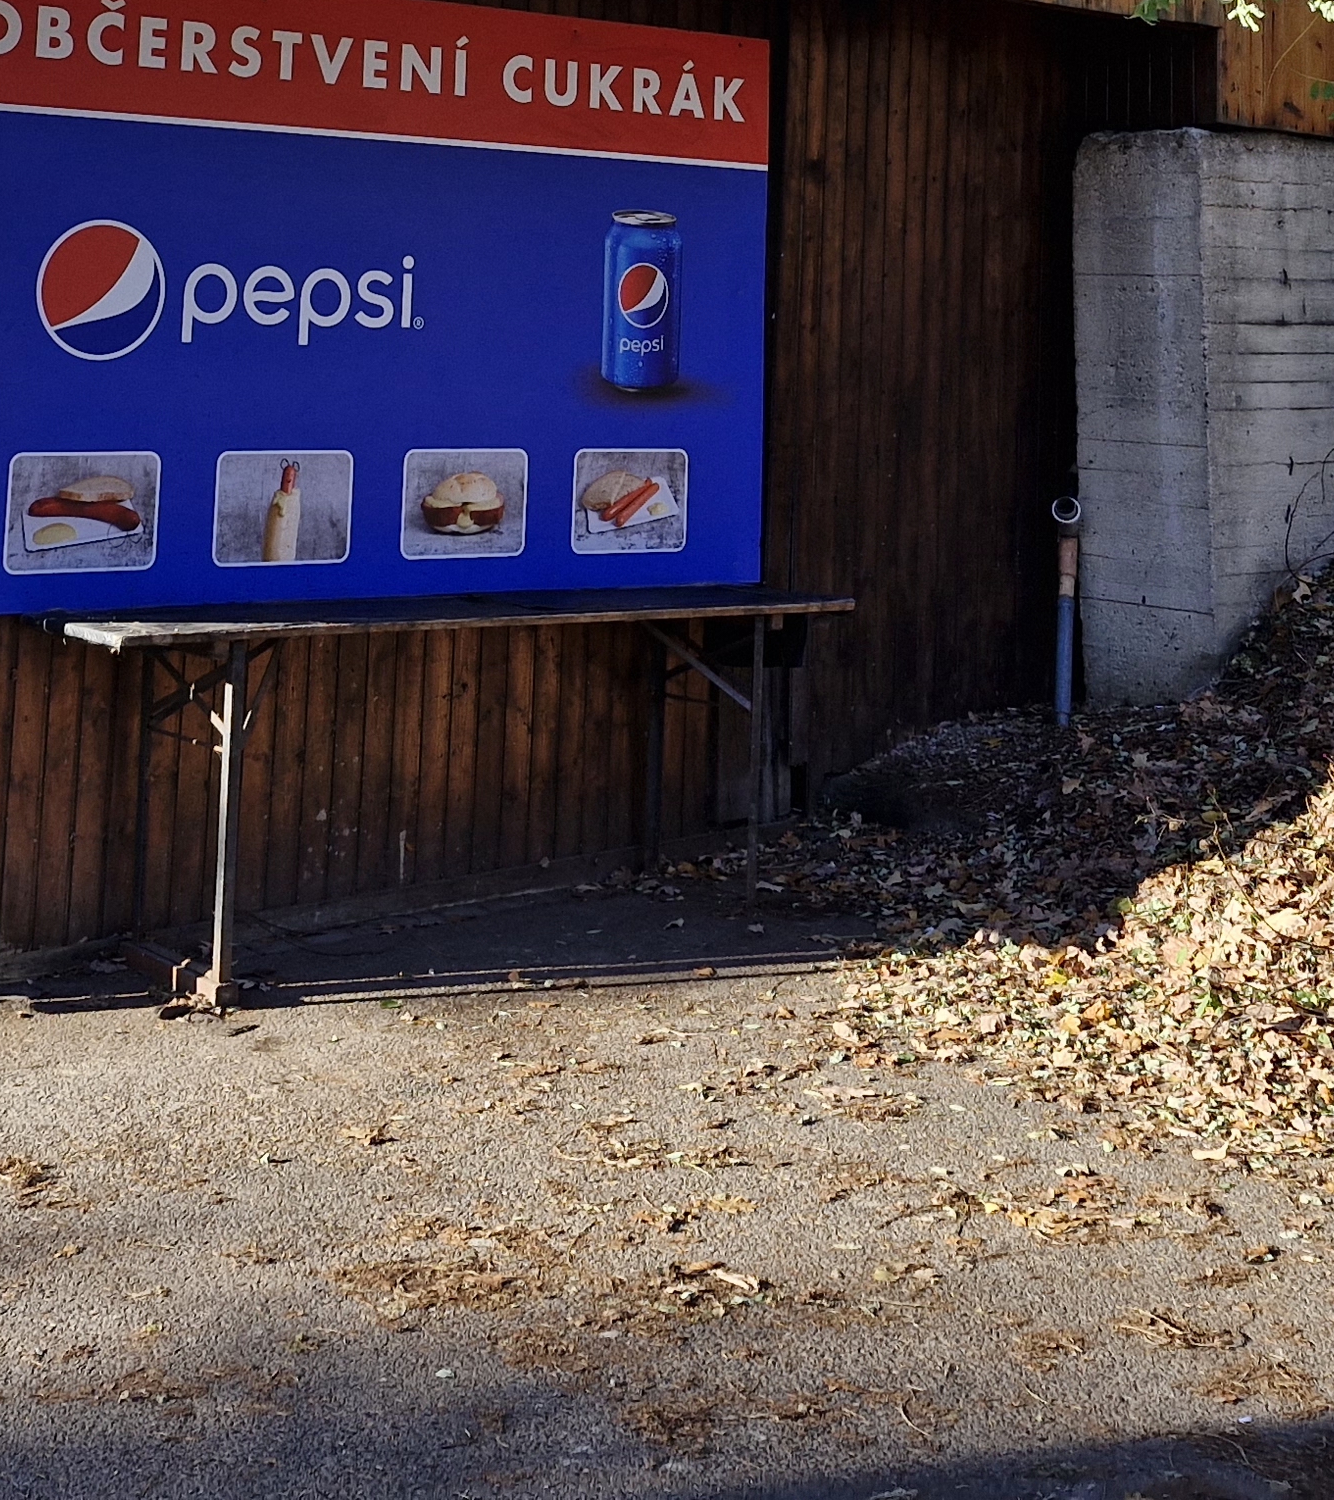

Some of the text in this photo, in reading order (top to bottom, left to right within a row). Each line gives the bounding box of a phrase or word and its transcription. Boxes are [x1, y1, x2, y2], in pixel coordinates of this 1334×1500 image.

[501, 53, 748, 124] CUKRÁK
[180, 255, 415, 346] pepsi
[618, 335, 665, 357] pepsi
